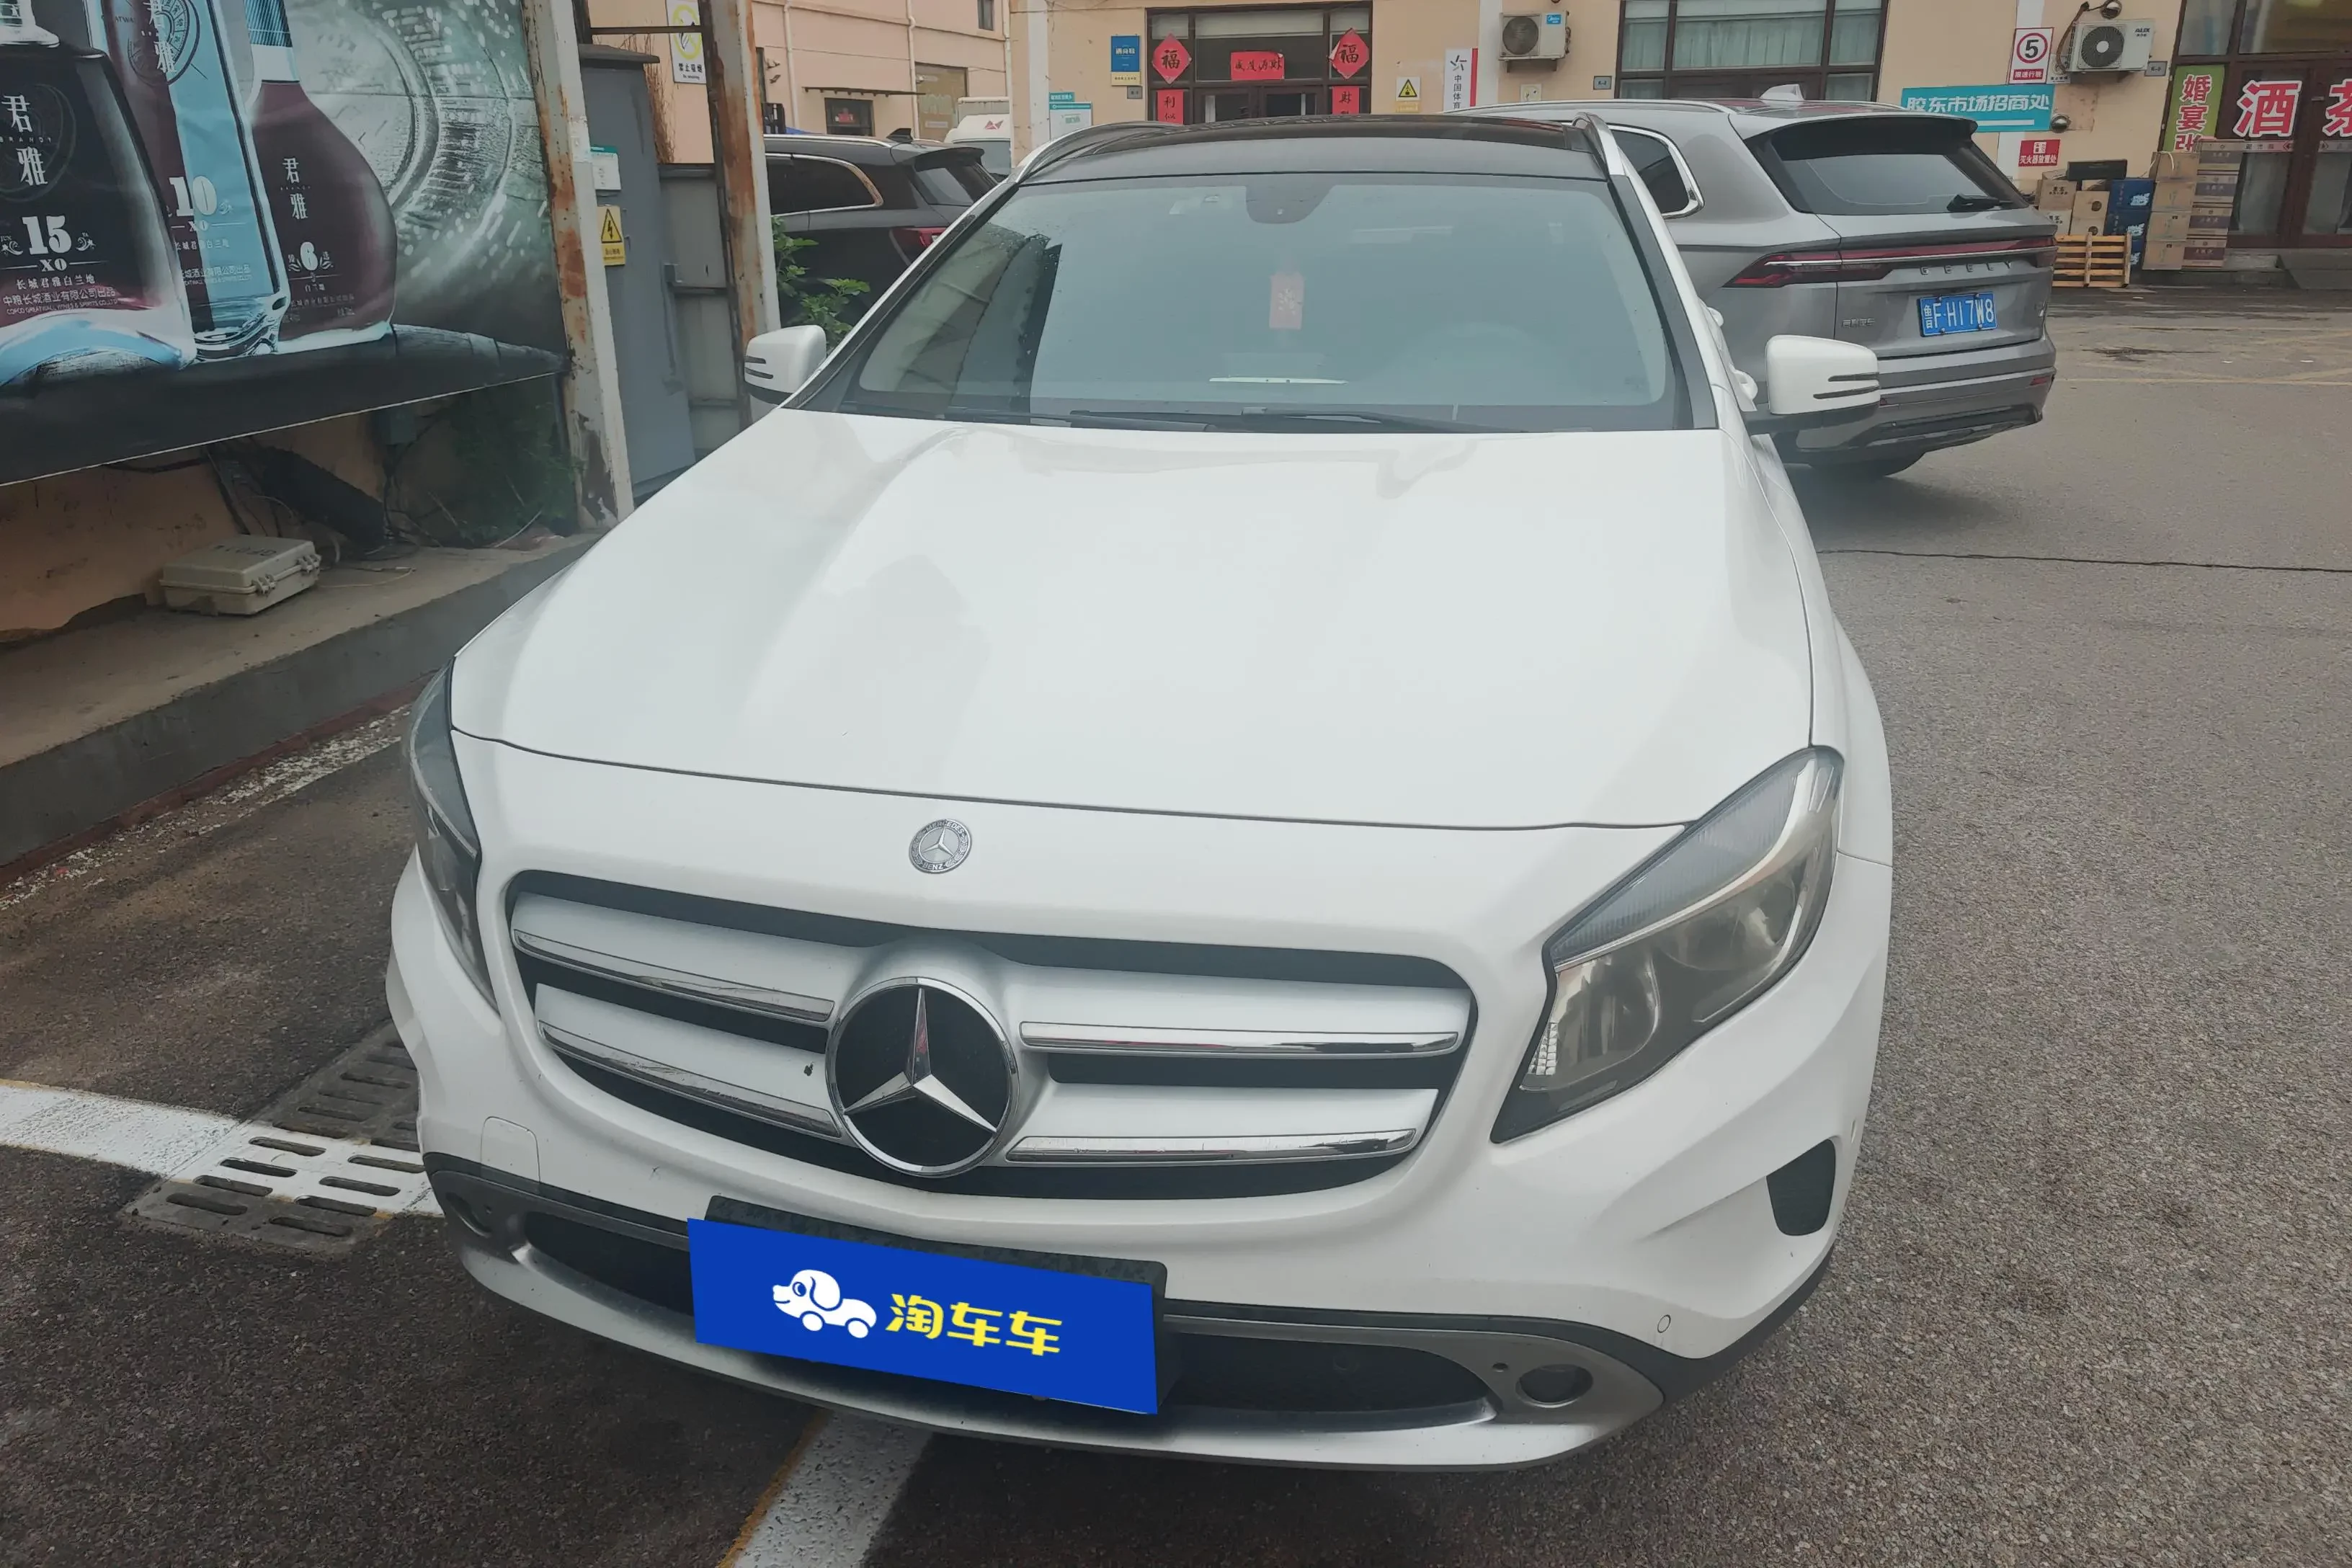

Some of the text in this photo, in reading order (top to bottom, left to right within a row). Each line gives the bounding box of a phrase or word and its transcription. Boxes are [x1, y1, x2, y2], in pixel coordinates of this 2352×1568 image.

[1339, 44, 1359, 64] 福
[2024, 39, 2039, 58] 5
[1161, 50, 1180, 69] 福
[1907, 94, 2049, 112] 胶东市场招商处
[2020, 154, 2057, 164] 灭火器放置处
[169, 176, 216, 216] 10
[22, 215, 71, 254] 15
[39, 258, 67, 272] XO
[300, 241, 318, 271] 6
[1920, 261, 2012, 275] GEELY
[17, 273, 95, 290] 长城君雅白兰地
[3, 287, 116, 306] 中粮长城酒业有限公司出品
